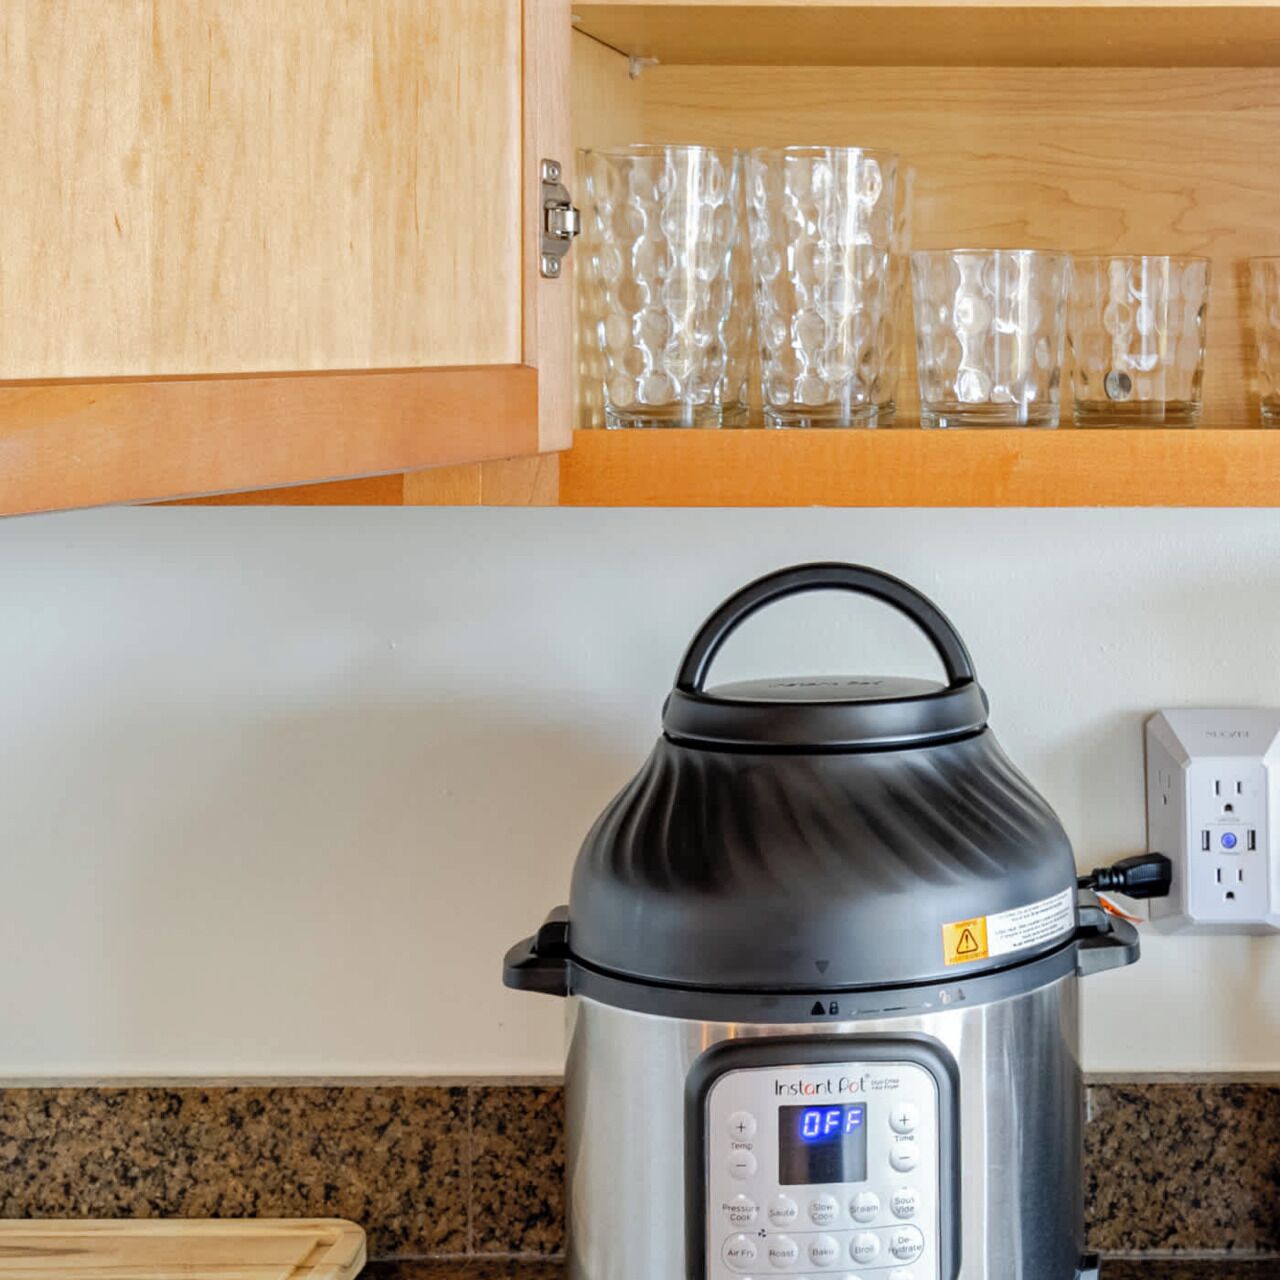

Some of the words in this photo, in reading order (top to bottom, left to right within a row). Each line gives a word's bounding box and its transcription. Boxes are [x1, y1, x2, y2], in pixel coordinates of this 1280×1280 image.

[775, 1079, 833, 1096] Instant
[839, 1077, 867, 1094] Pot
[803, 1109, 862, 1138] OFF
[731, 1142, 753, 1152] Temp
[728, 1249, 740, 1257] Air
[741, 1249, 755, 1258] Fry
